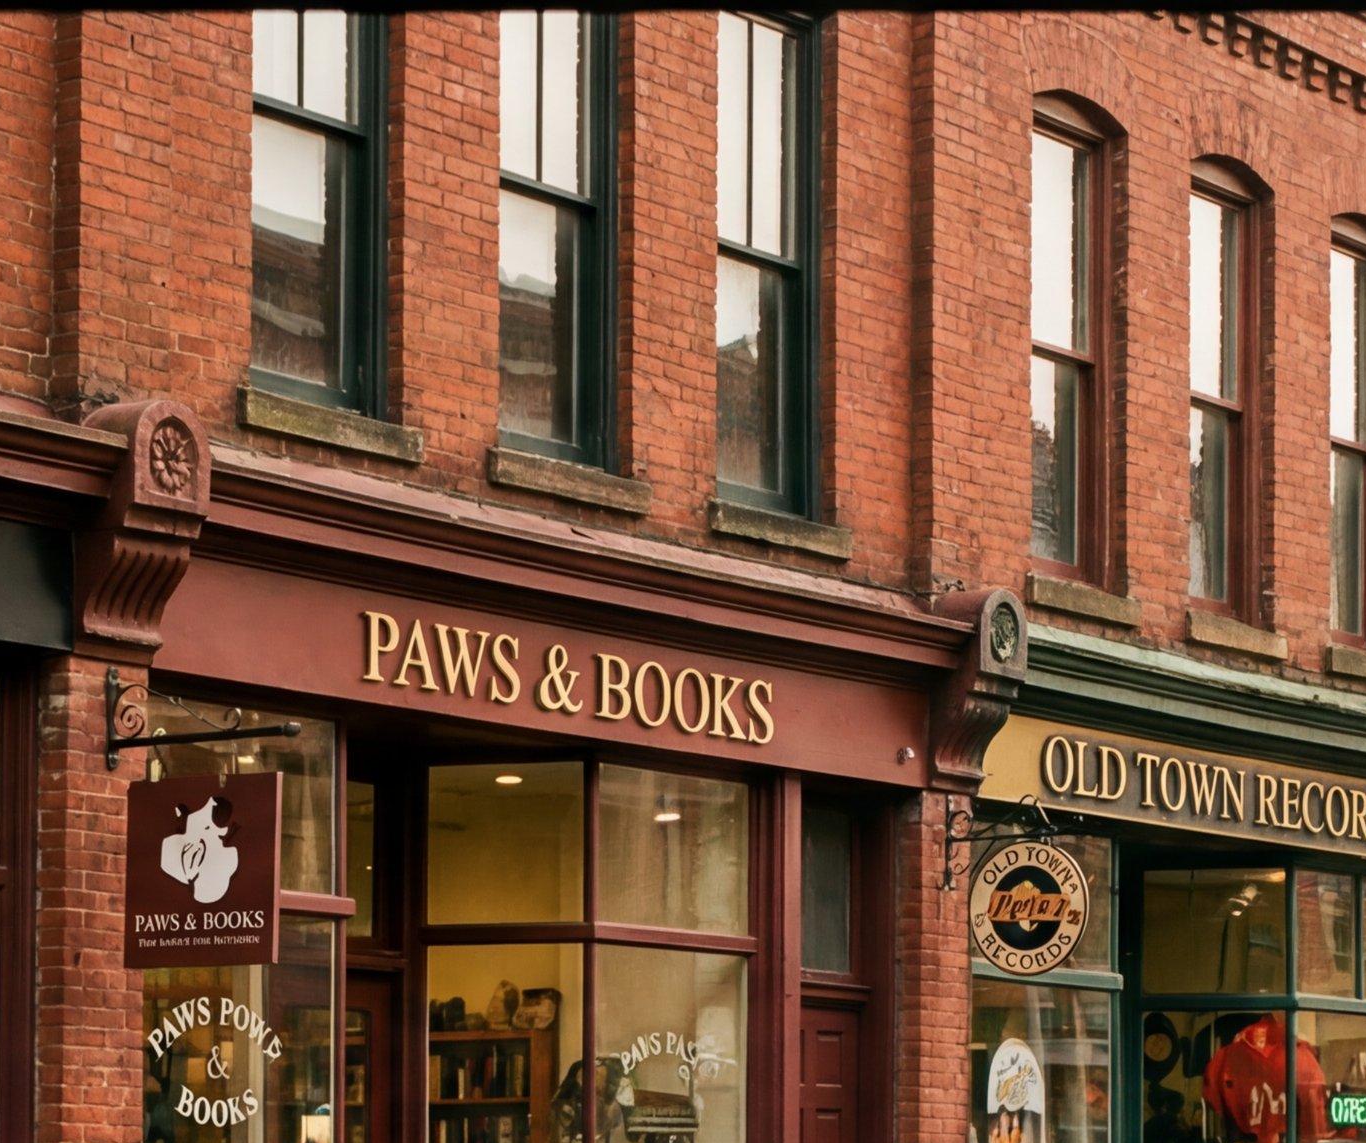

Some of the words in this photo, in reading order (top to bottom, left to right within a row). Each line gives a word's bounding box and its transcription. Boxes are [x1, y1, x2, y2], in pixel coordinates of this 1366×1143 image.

[362, 610, 521, 704] PAWS
[539, 644, 583, 714] &
[594, 652, 775, 745] BOOKS
[1044, 736, 1127, 800] OLD
[1136, 752, 1246, 822] TOWN
[983, 850, 1019, 885] OLD
[135, 913, 180, 933] PAWS
[184, 912, 197, 931] &
[203, 910, 265, 930] BOOKS
[147, 996, 211, 1060] PAWS
[207, 1045, 230, 1079] &
[174, 1084, 259, 1128] BOOKS
